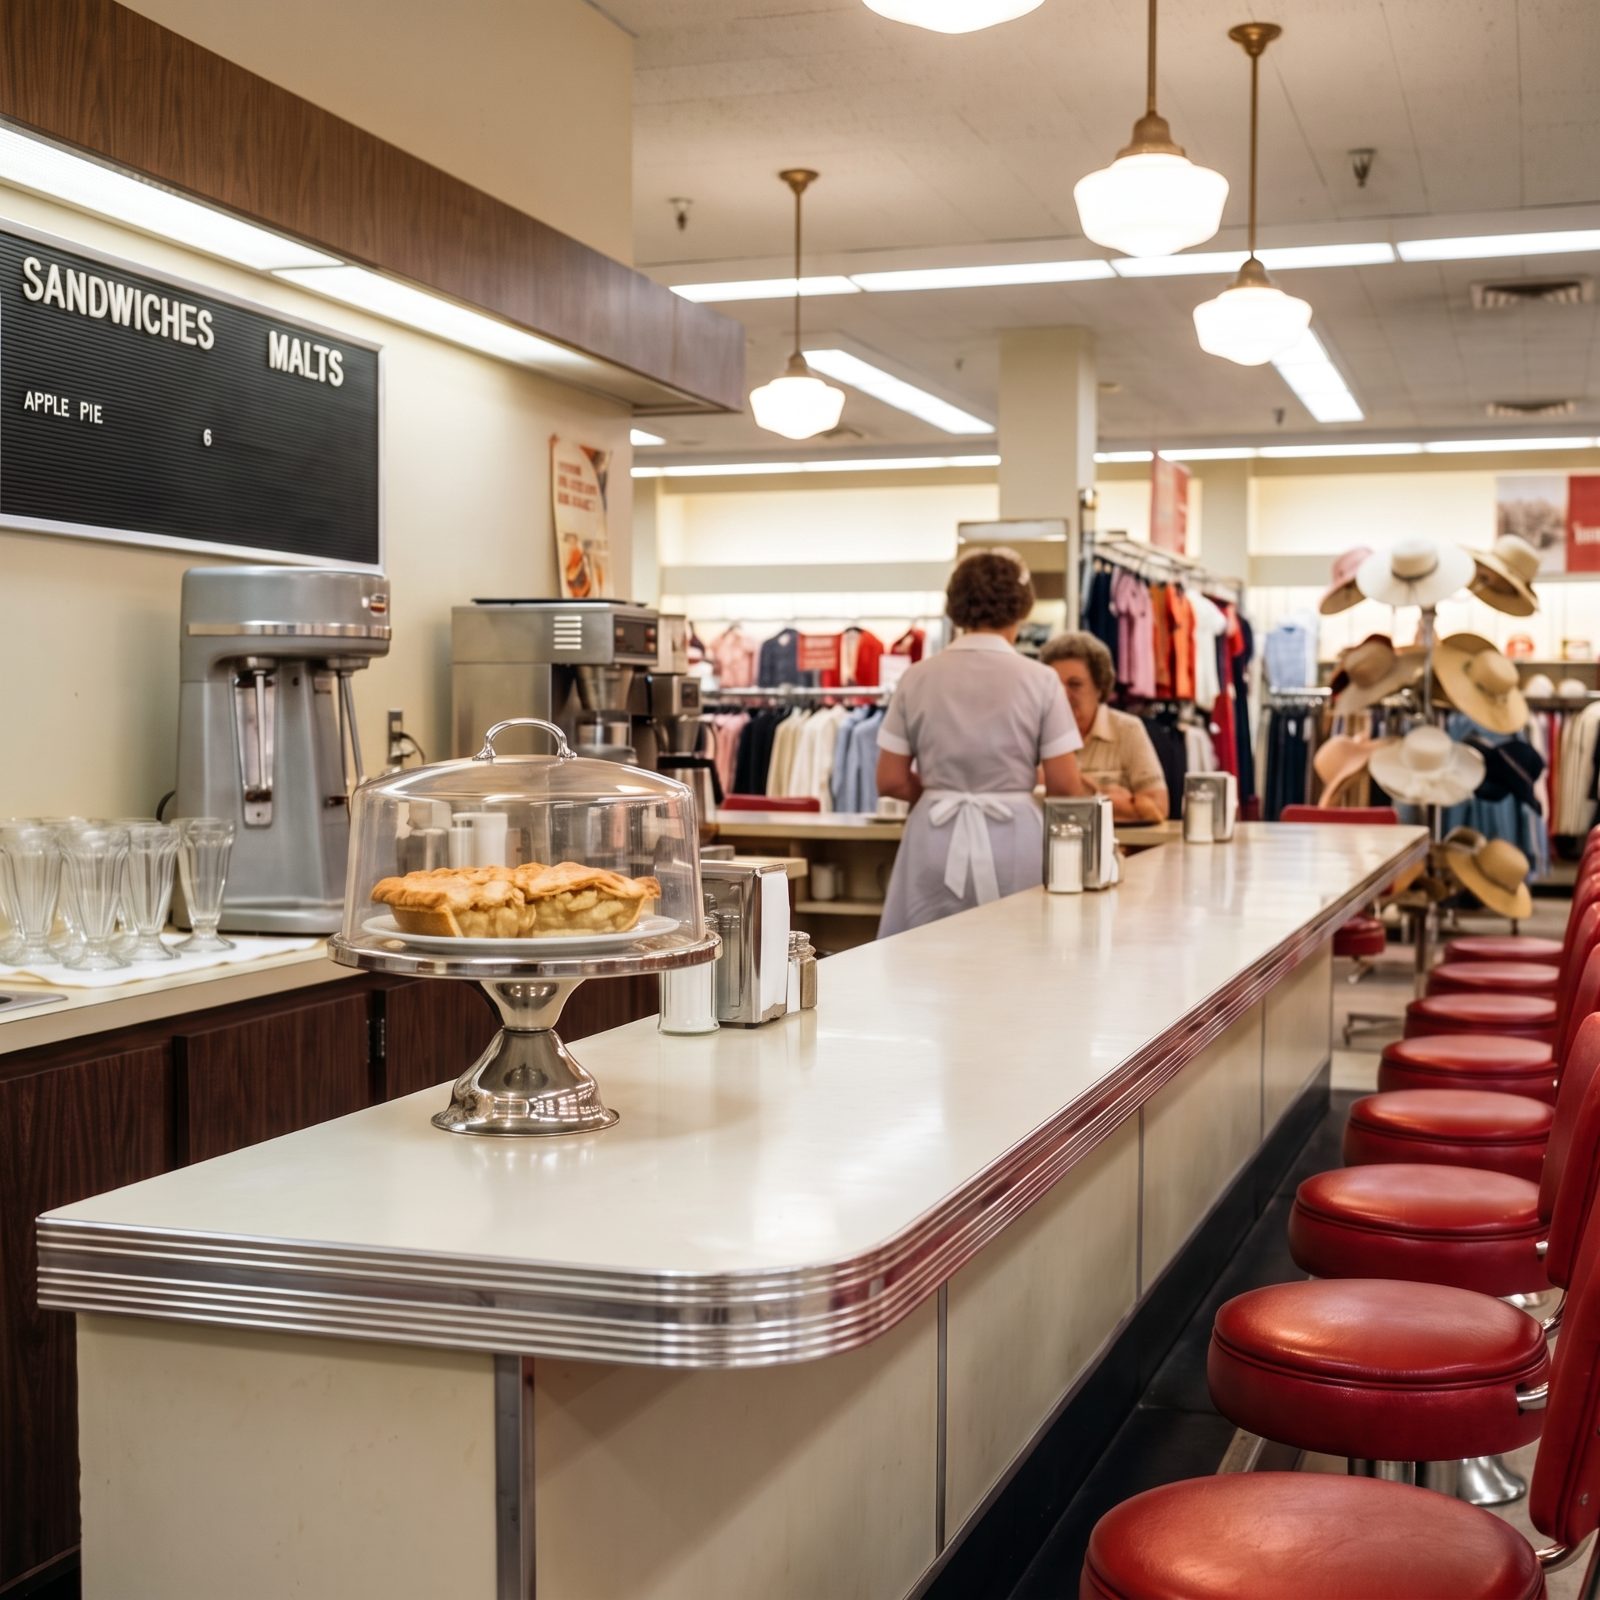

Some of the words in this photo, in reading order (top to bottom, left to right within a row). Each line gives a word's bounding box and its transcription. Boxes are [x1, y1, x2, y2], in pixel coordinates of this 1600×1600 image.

[22, 256, 215, 350] SANDWICHES
[268, 330, 344, 387] MALTS
[24, 390, 70, 418] APPLE
[79, 401, 104, 424] PIE
[203, 428, 212, 446] 6
